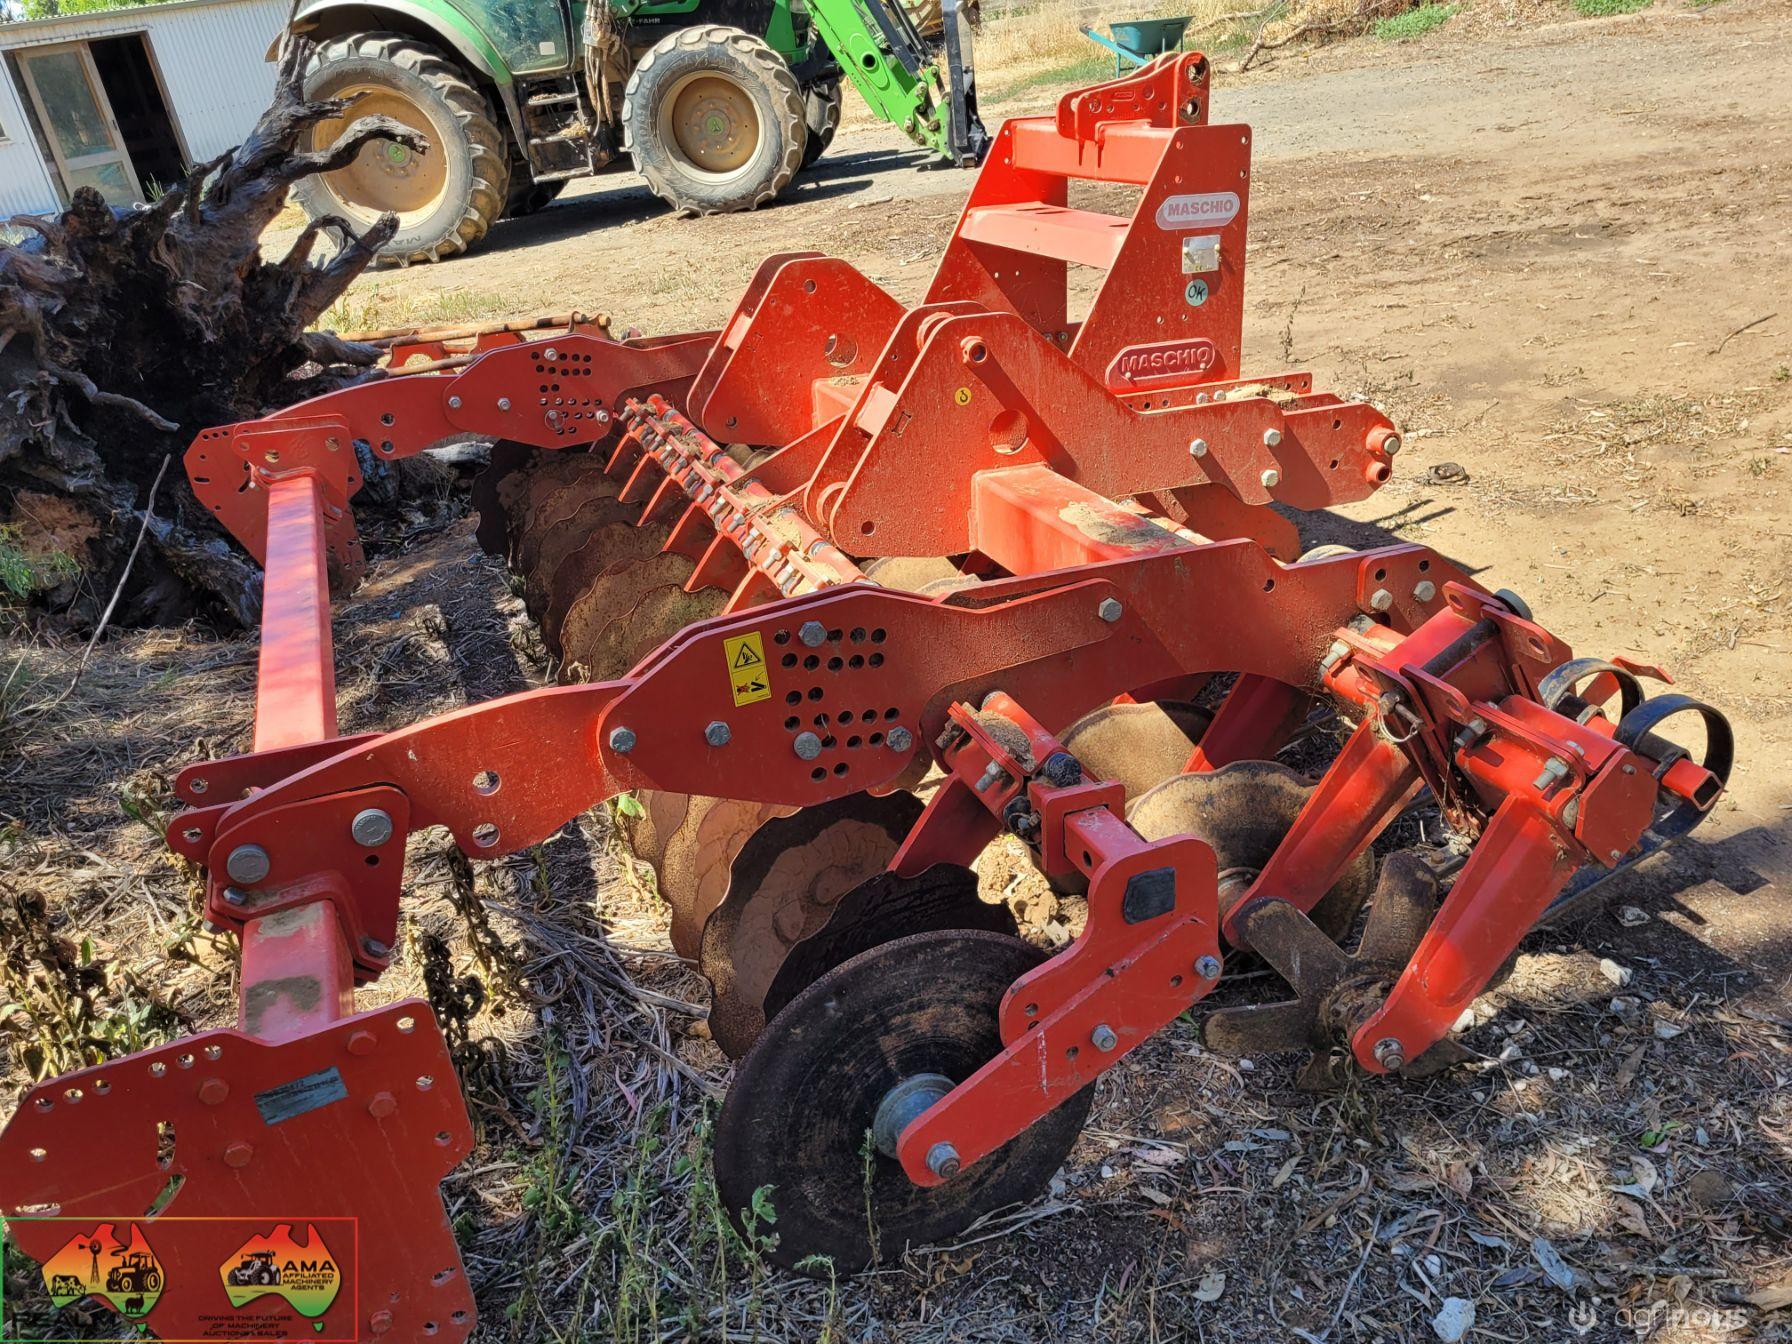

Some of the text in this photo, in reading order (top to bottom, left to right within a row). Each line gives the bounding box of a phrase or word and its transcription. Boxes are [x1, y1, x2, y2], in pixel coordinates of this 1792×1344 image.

[1167, 199, 1233, 217] MASCHIO
[1188, 285, 1206, 301] OK
[1121, 346, 1210, 372] MASCHIO
